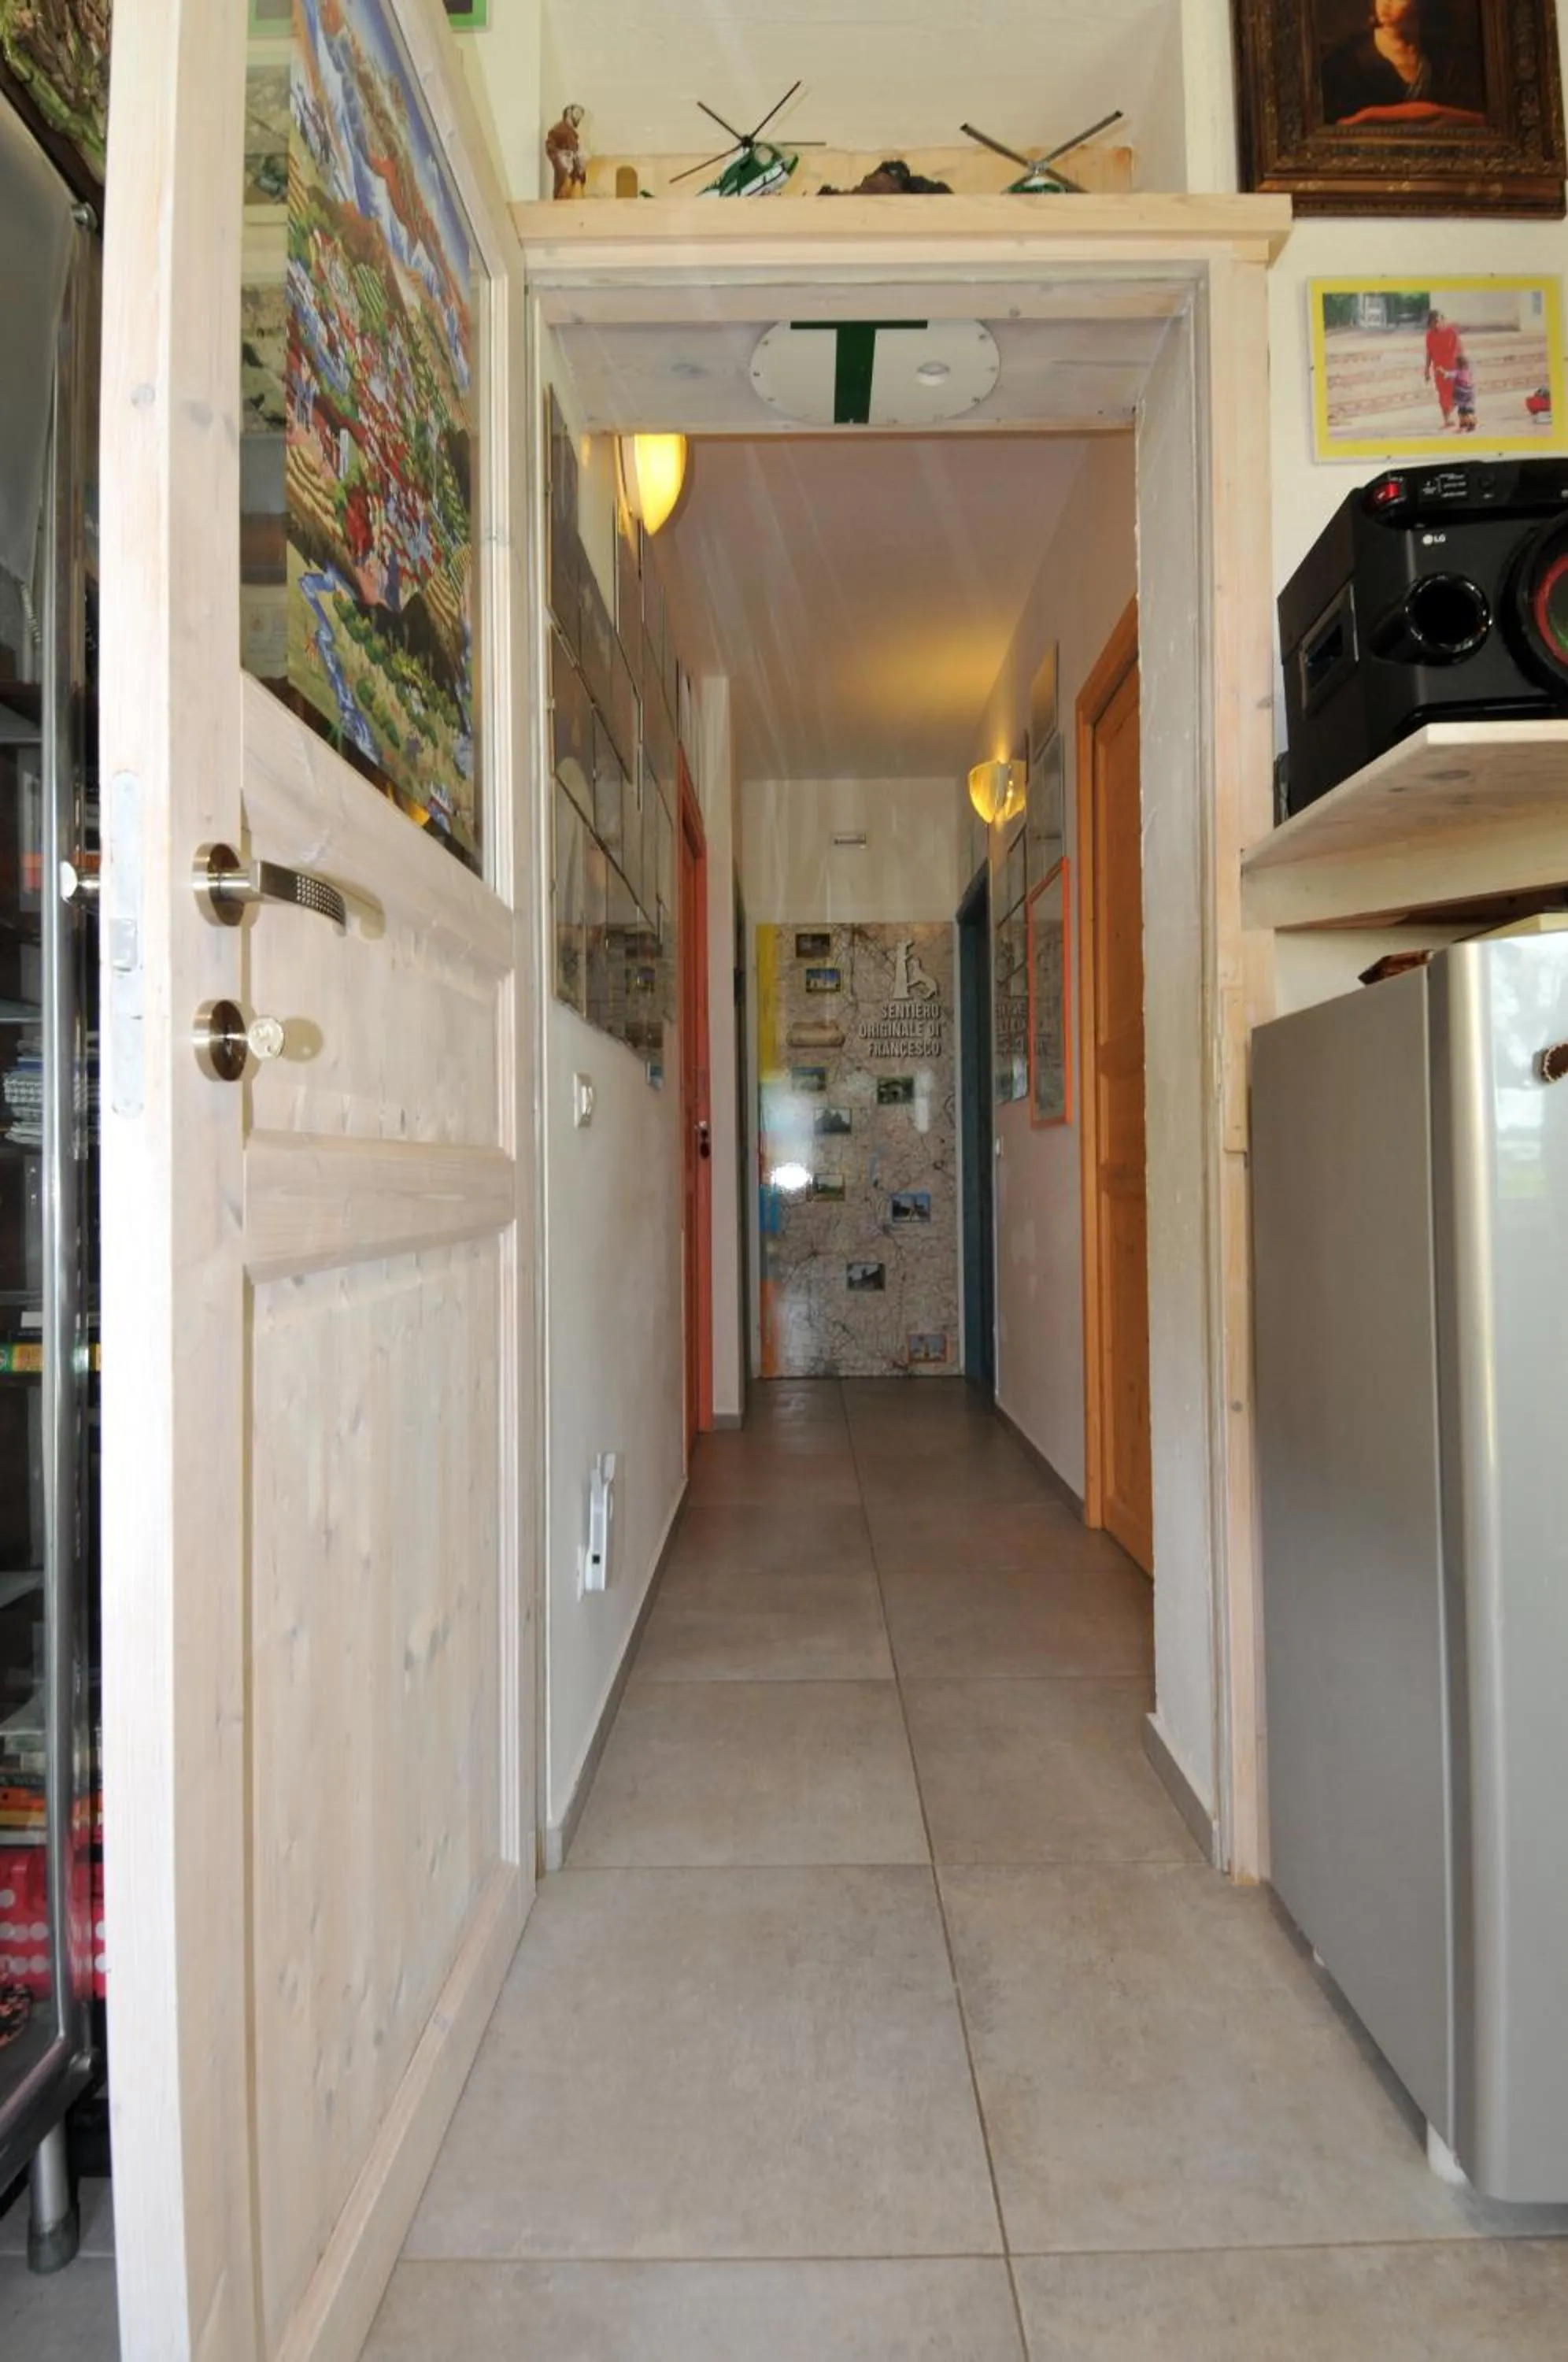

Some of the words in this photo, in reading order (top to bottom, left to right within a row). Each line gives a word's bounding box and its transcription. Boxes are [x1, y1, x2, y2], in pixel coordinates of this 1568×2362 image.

[1433, 533, 1446, 542] LG
[881, 1003, 941, 1020] SENTIERO
[859, 1023, 924, 1038] ORIGINALE
[868, 1040, 941, 1057] FRANCESCO
